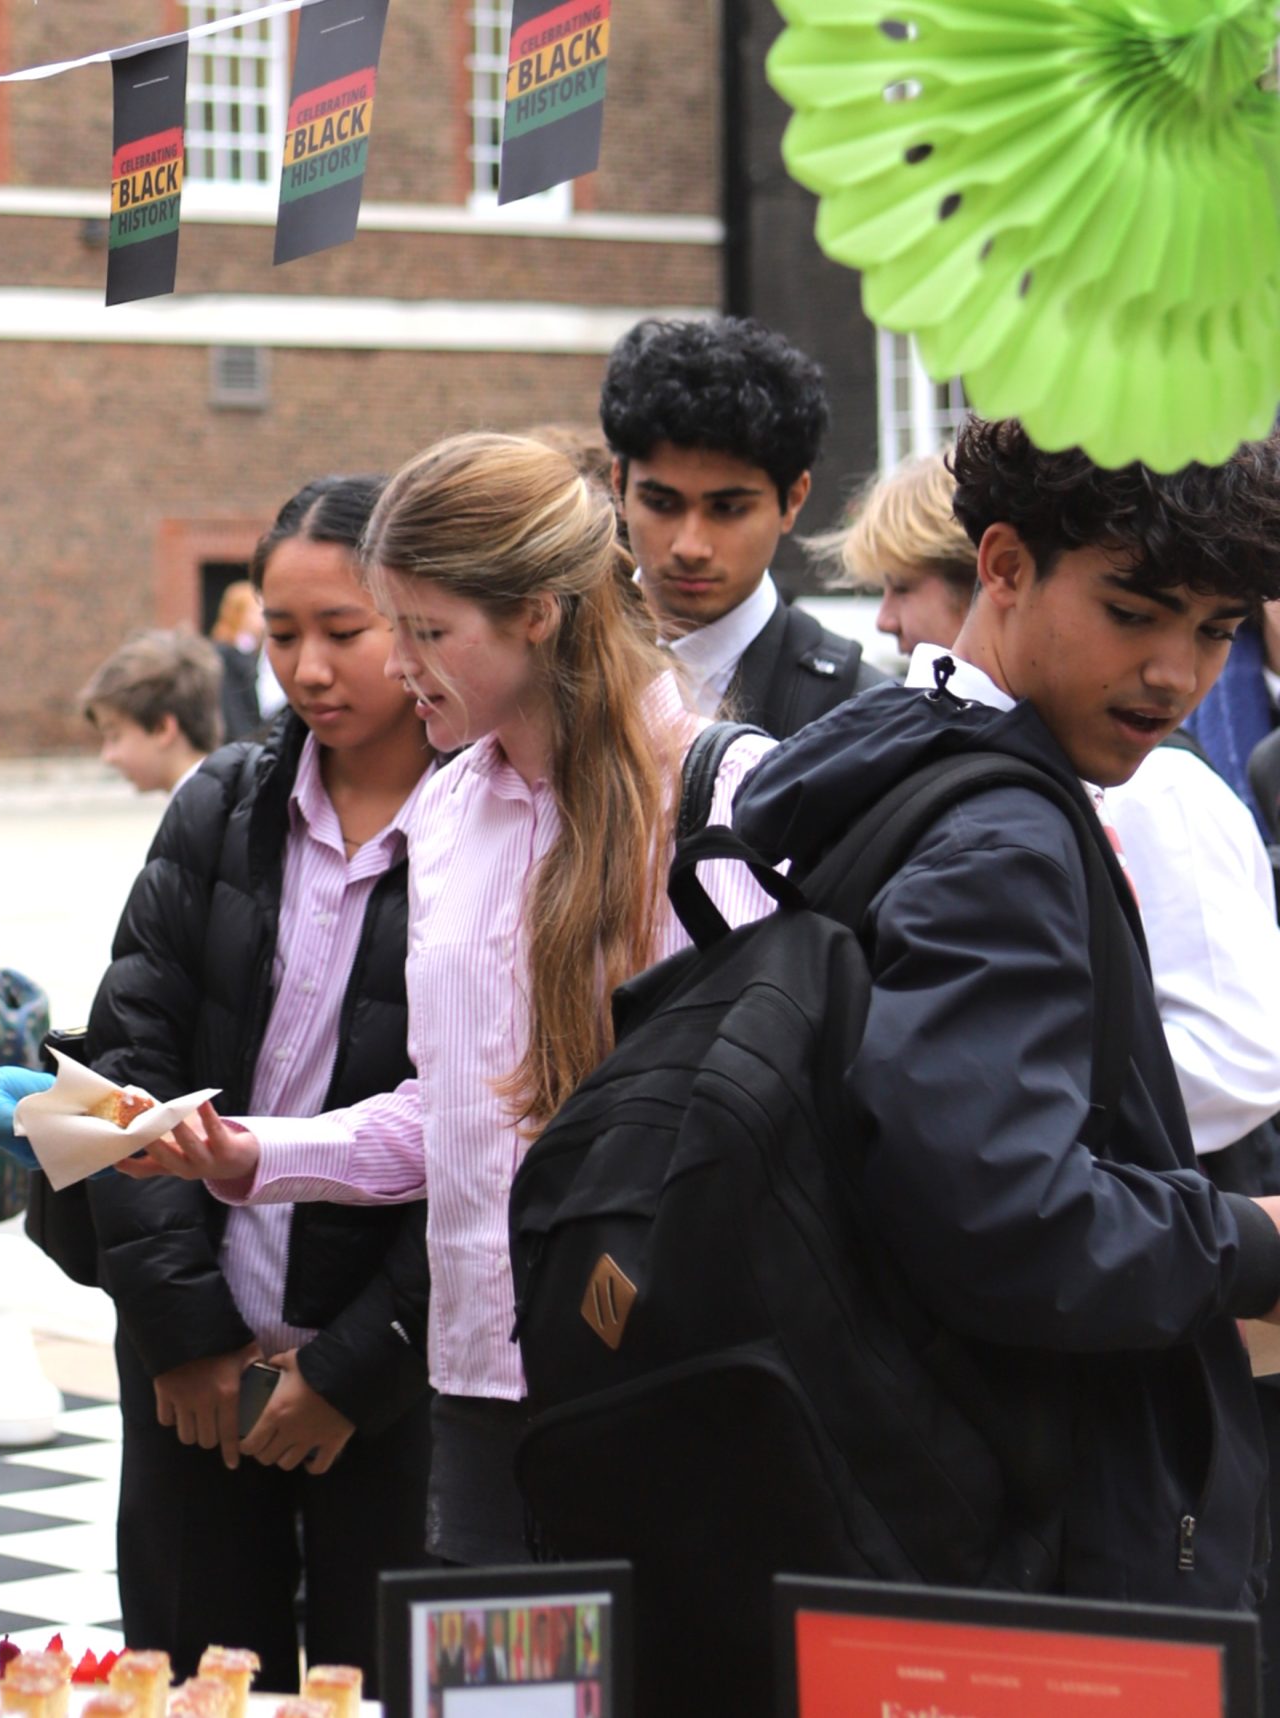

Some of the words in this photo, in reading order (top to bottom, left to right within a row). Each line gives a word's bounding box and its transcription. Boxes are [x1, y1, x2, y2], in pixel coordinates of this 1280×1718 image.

[518, 23, 602, 92] BLACK
[297, 84, 367, 125] CELEBRATING
[516, 64, 599, 123] HISTORY
[293, 103, 367, 160] BLACK
[121, 144, 177, 174] CELEBRATING
[291, 142, 362, 188] HISTORY
[119, 161, 178, 207] BLACK
[118, 199, 177, 235] HISTORY
